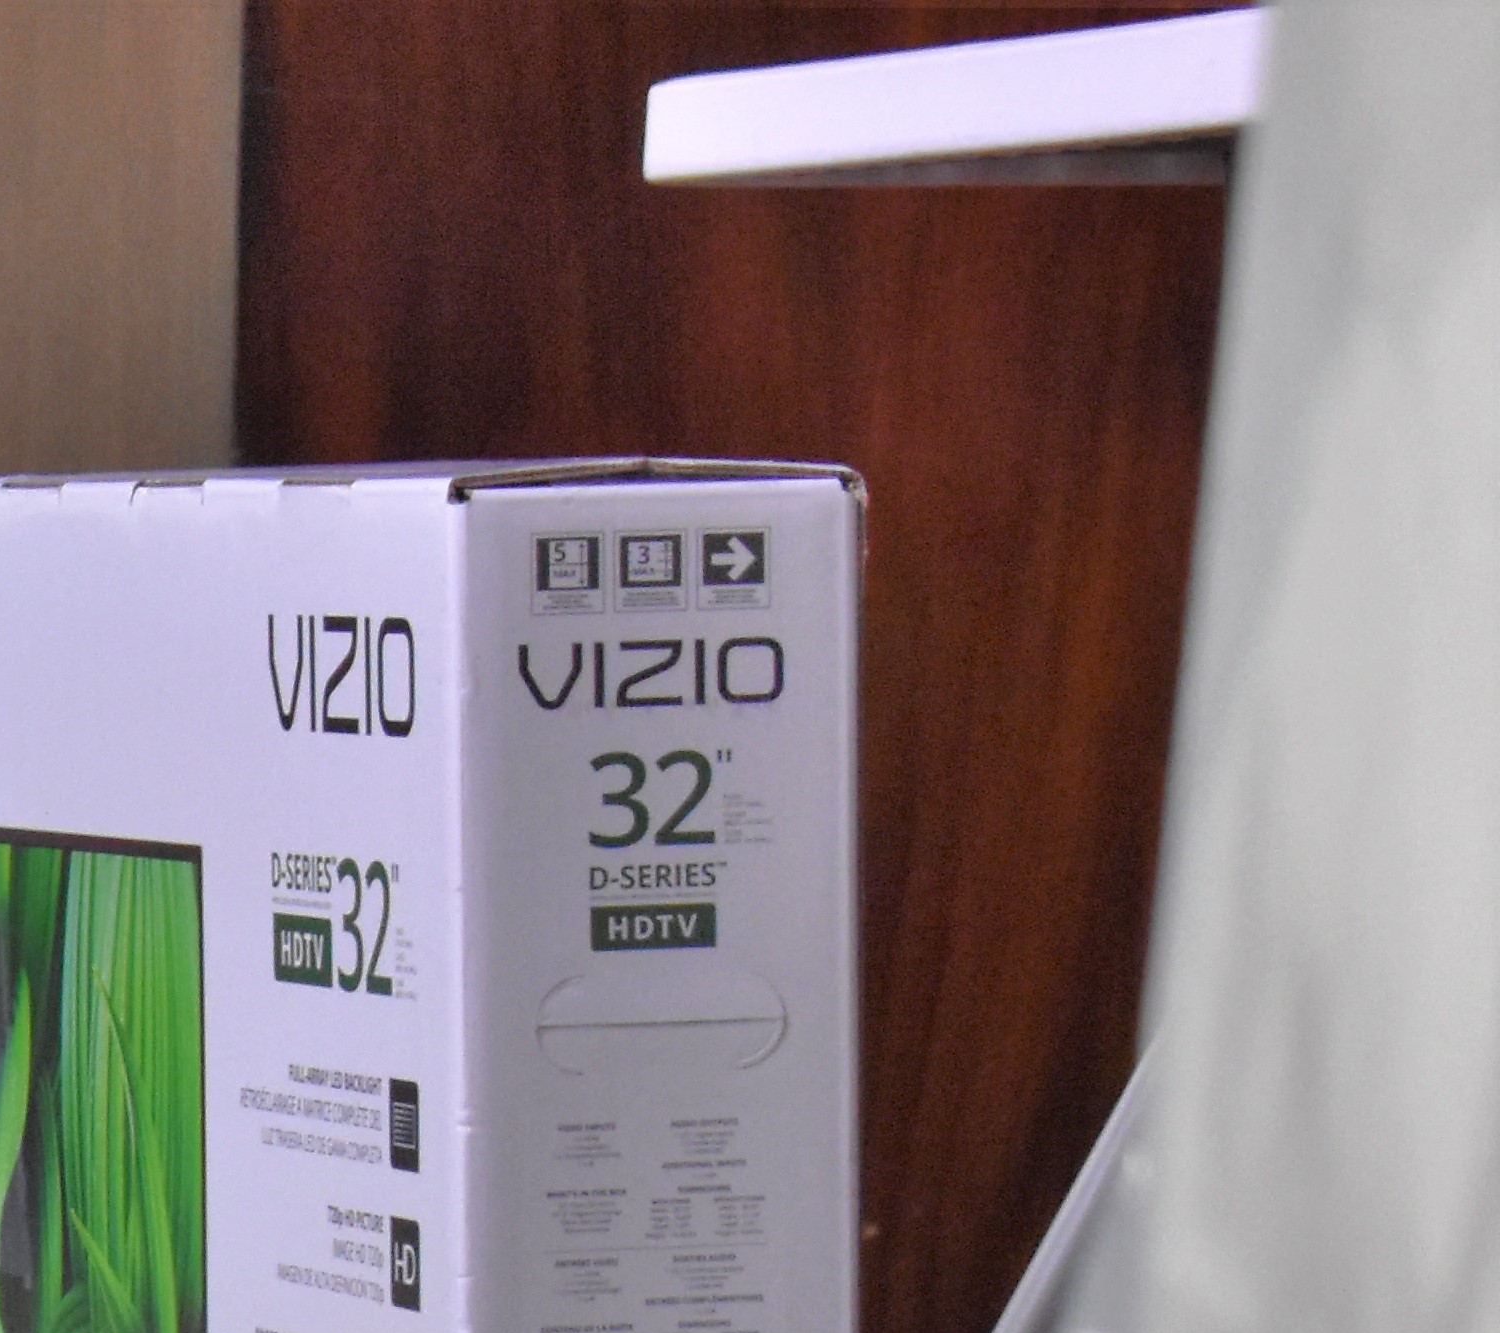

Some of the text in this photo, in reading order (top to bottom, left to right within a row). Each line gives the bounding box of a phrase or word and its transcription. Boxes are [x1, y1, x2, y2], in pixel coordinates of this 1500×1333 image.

[267, 613, 416, 738] VIZIO
[517, 636, 785, 711] VIZIO
[280, 929, 325, 970] HDTV
[607, 914, 698, 942] HDTV
[394, 1241, 416, 1286] HD
